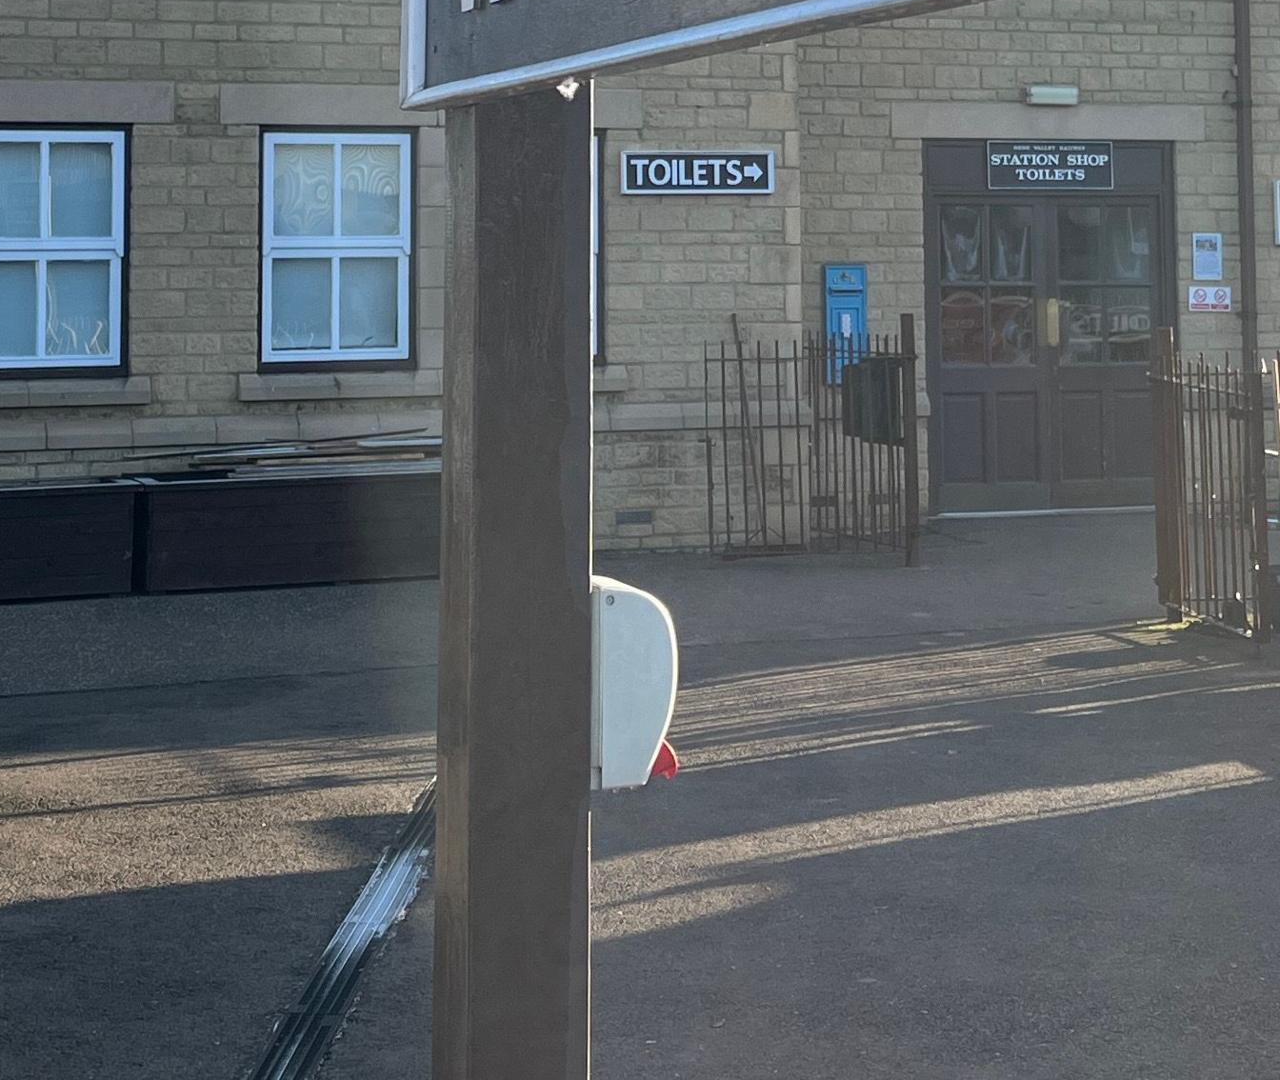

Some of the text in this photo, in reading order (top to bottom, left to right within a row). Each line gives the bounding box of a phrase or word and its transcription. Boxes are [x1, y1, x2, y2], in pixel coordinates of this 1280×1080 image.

[990, 154, 1109, 166] STATION SHOP
[630, 159, 743, 186] TOILETS
[1015, 169, 1086, 181] TOILETS
